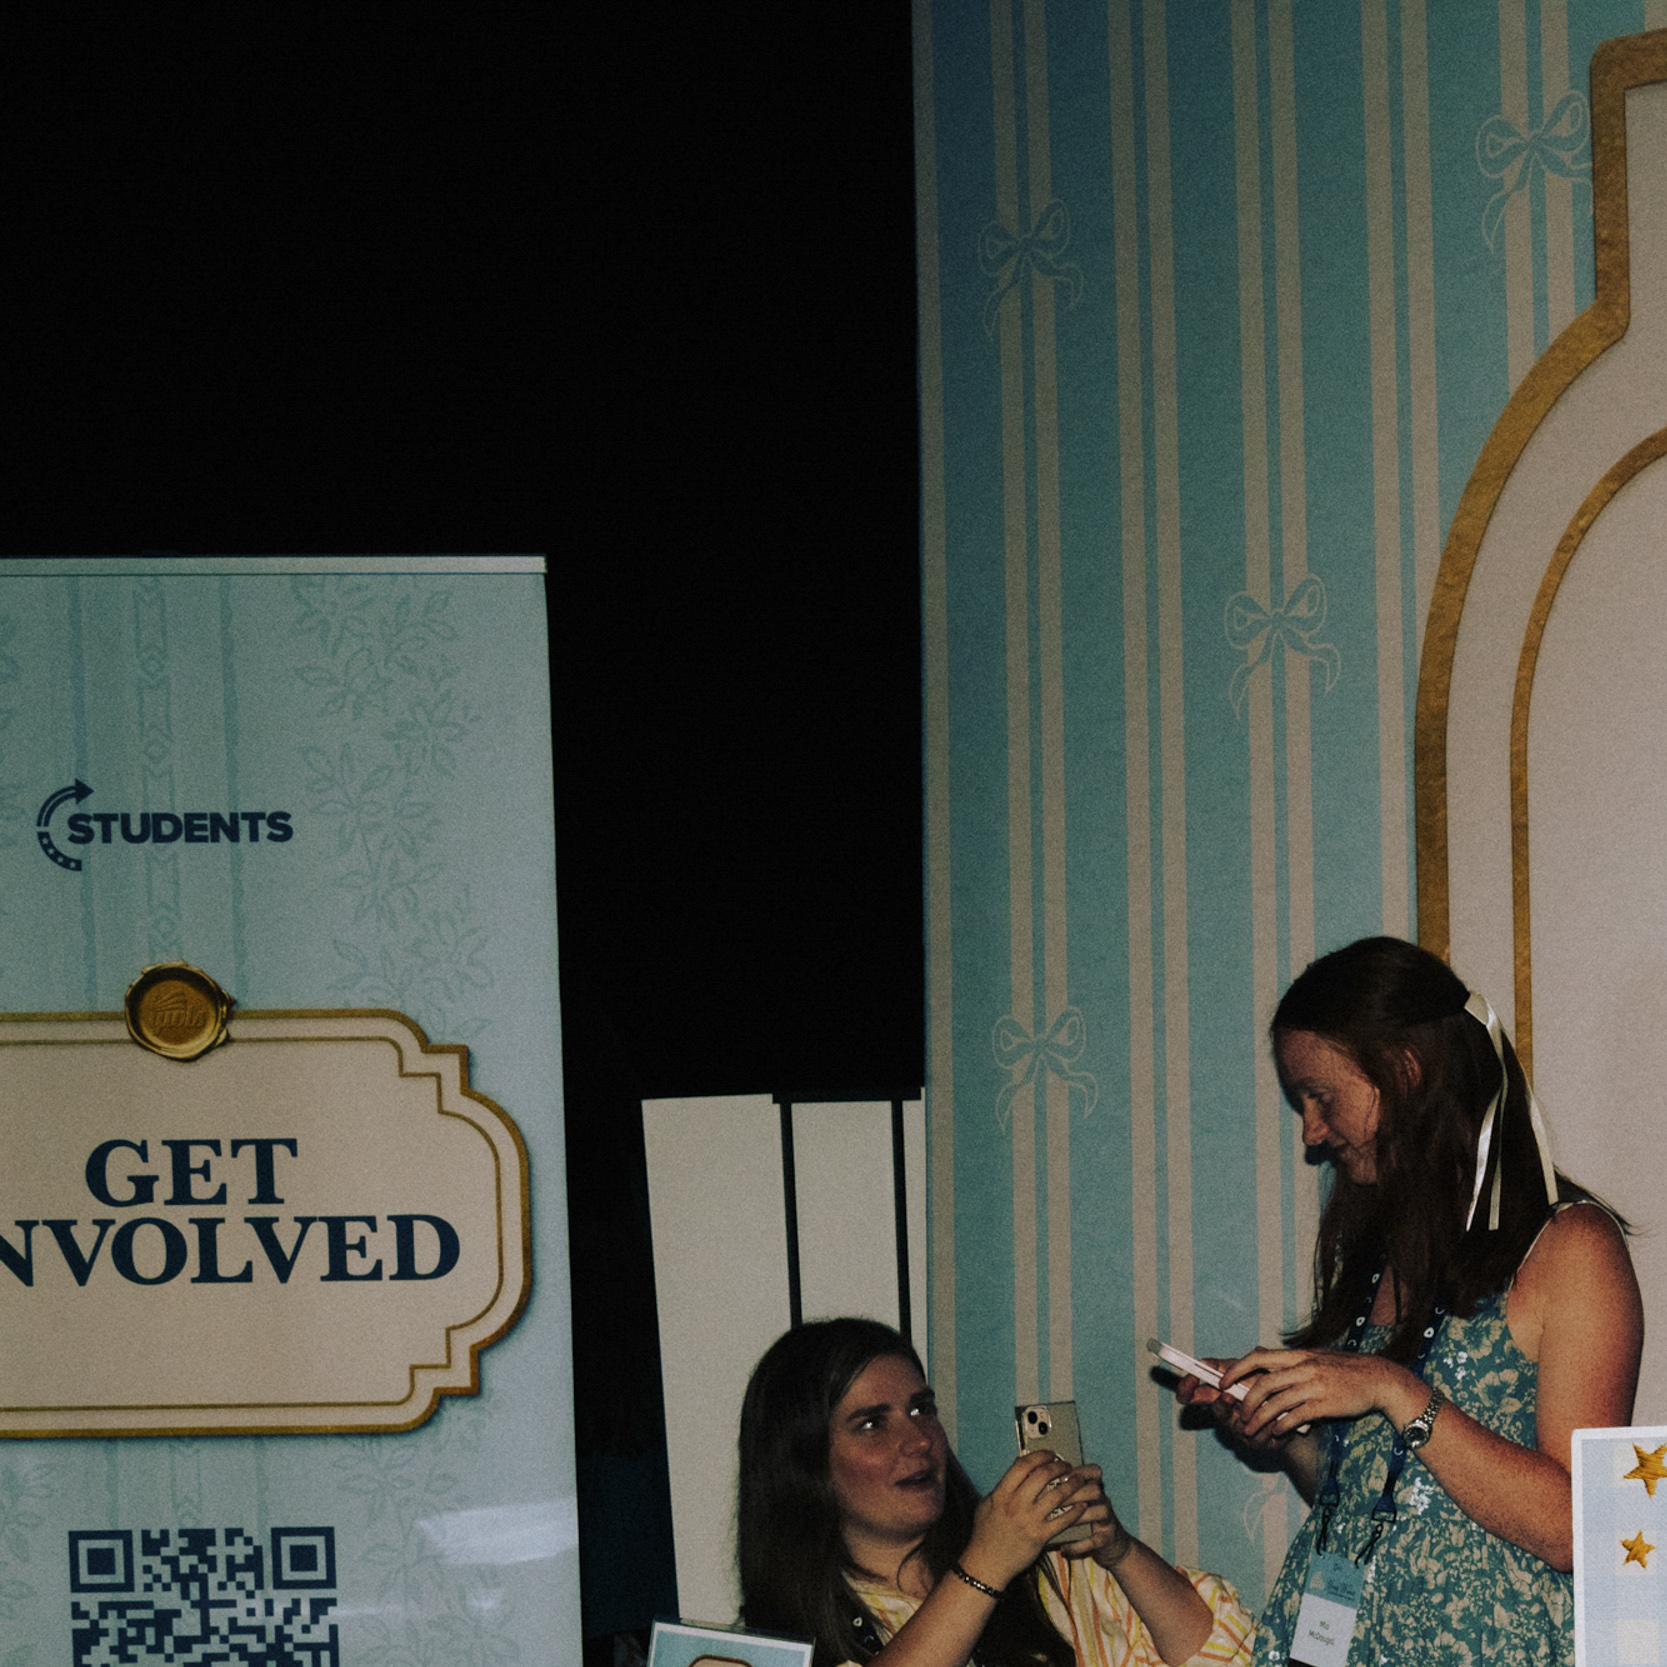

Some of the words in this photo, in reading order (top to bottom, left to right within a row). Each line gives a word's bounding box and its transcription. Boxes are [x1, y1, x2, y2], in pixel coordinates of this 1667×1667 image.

[67, 811, 294, 845] STUDENTS
[85, 1138, 299, 1207] GET
[0, 1214, 461, 1287] NVOLVED
